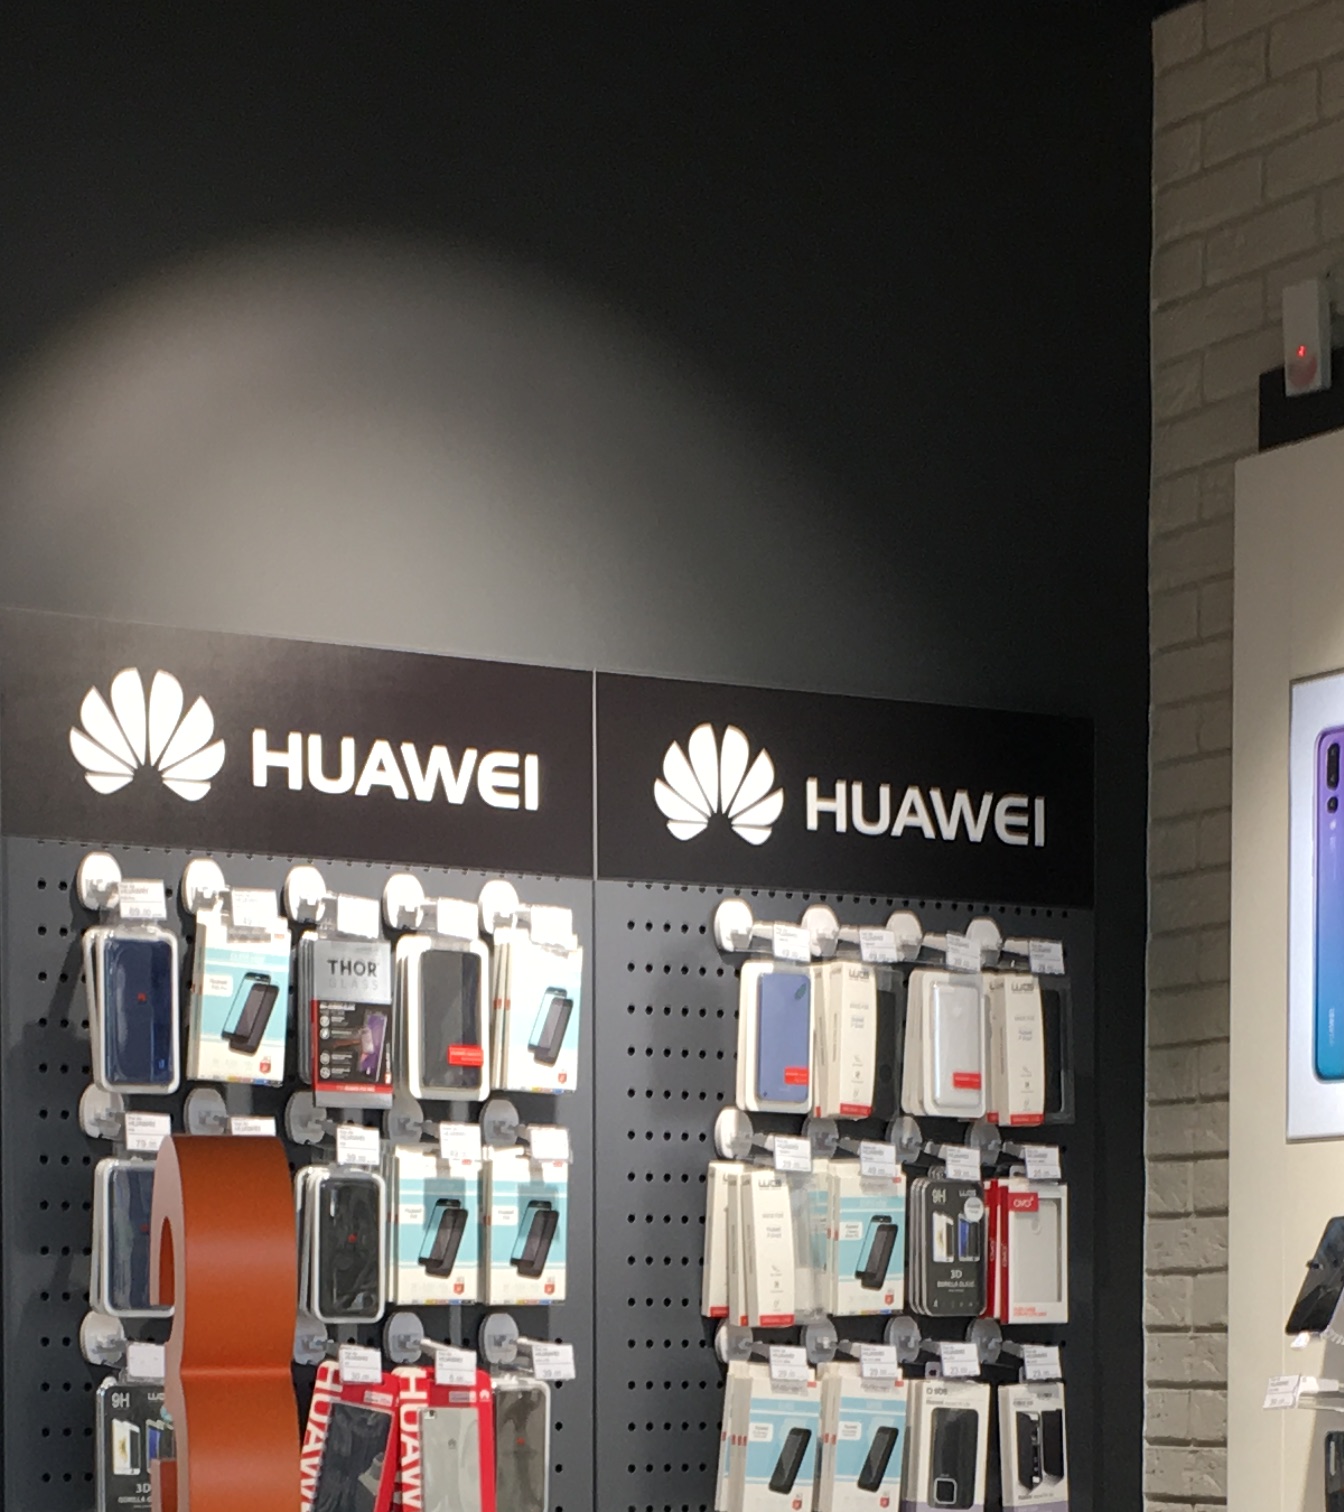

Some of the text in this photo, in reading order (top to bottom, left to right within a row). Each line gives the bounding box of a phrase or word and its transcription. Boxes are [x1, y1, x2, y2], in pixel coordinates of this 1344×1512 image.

[252, 728, 540, 811] HUAWEI
[806, 776, 1046, 847] HUAWEI
[327, 958, 378, 978] THOR
[328, 977, 379, 991] GLASS
[111, 1392, 131, 1410] 9H
